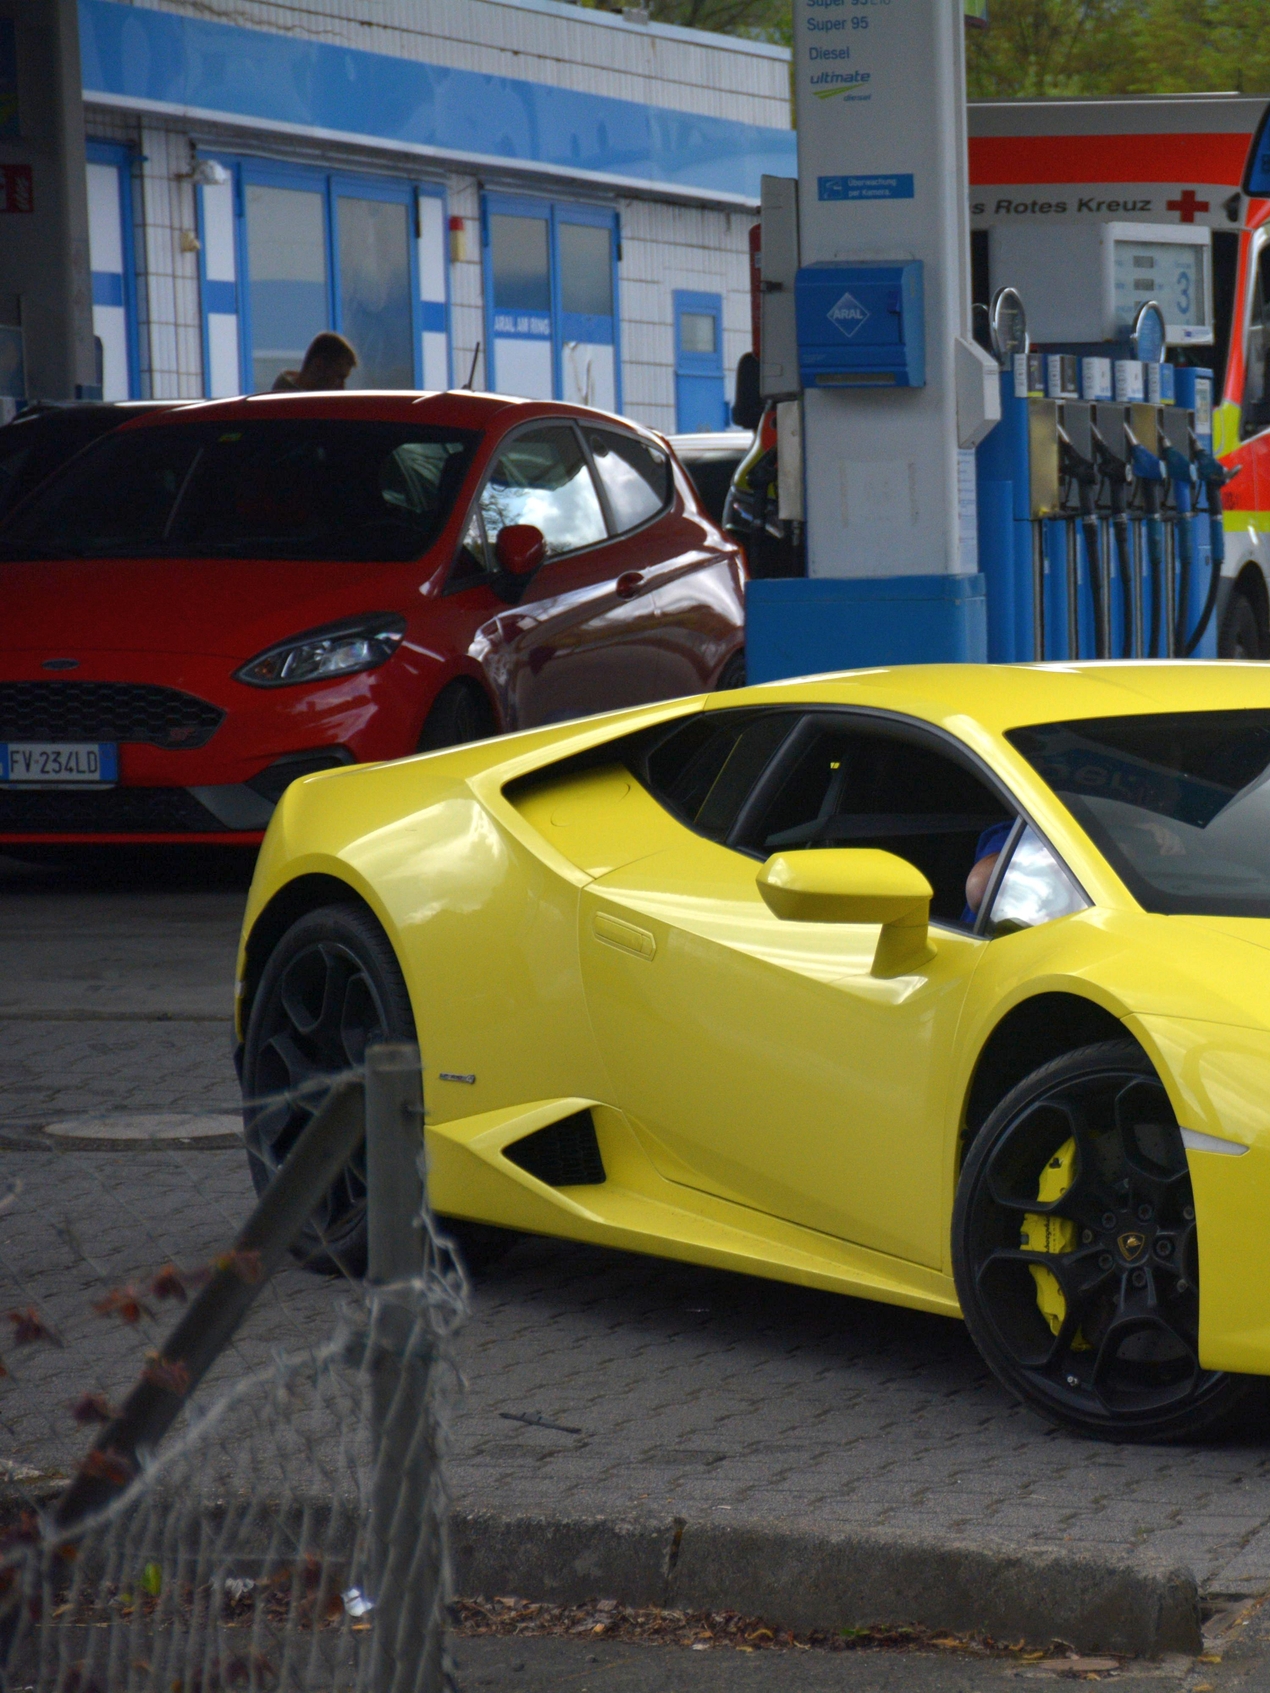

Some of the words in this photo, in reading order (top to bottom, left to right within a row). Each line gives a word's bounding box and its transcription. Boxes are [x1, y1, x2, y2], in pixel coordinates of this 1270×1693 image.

[806, 17, 847, 33] Super
[851, 16, 869, 30] 95
[808, 46, 850, 60] Diesel
[809, 70, 871, 84] ultimate
[994, 199, 1068, 215] Rotes
[1077, 197, 1153, 213] Kreuz
[1176, 271, 1192, 316] 3
[833, 308, 863, 320] ARAL
